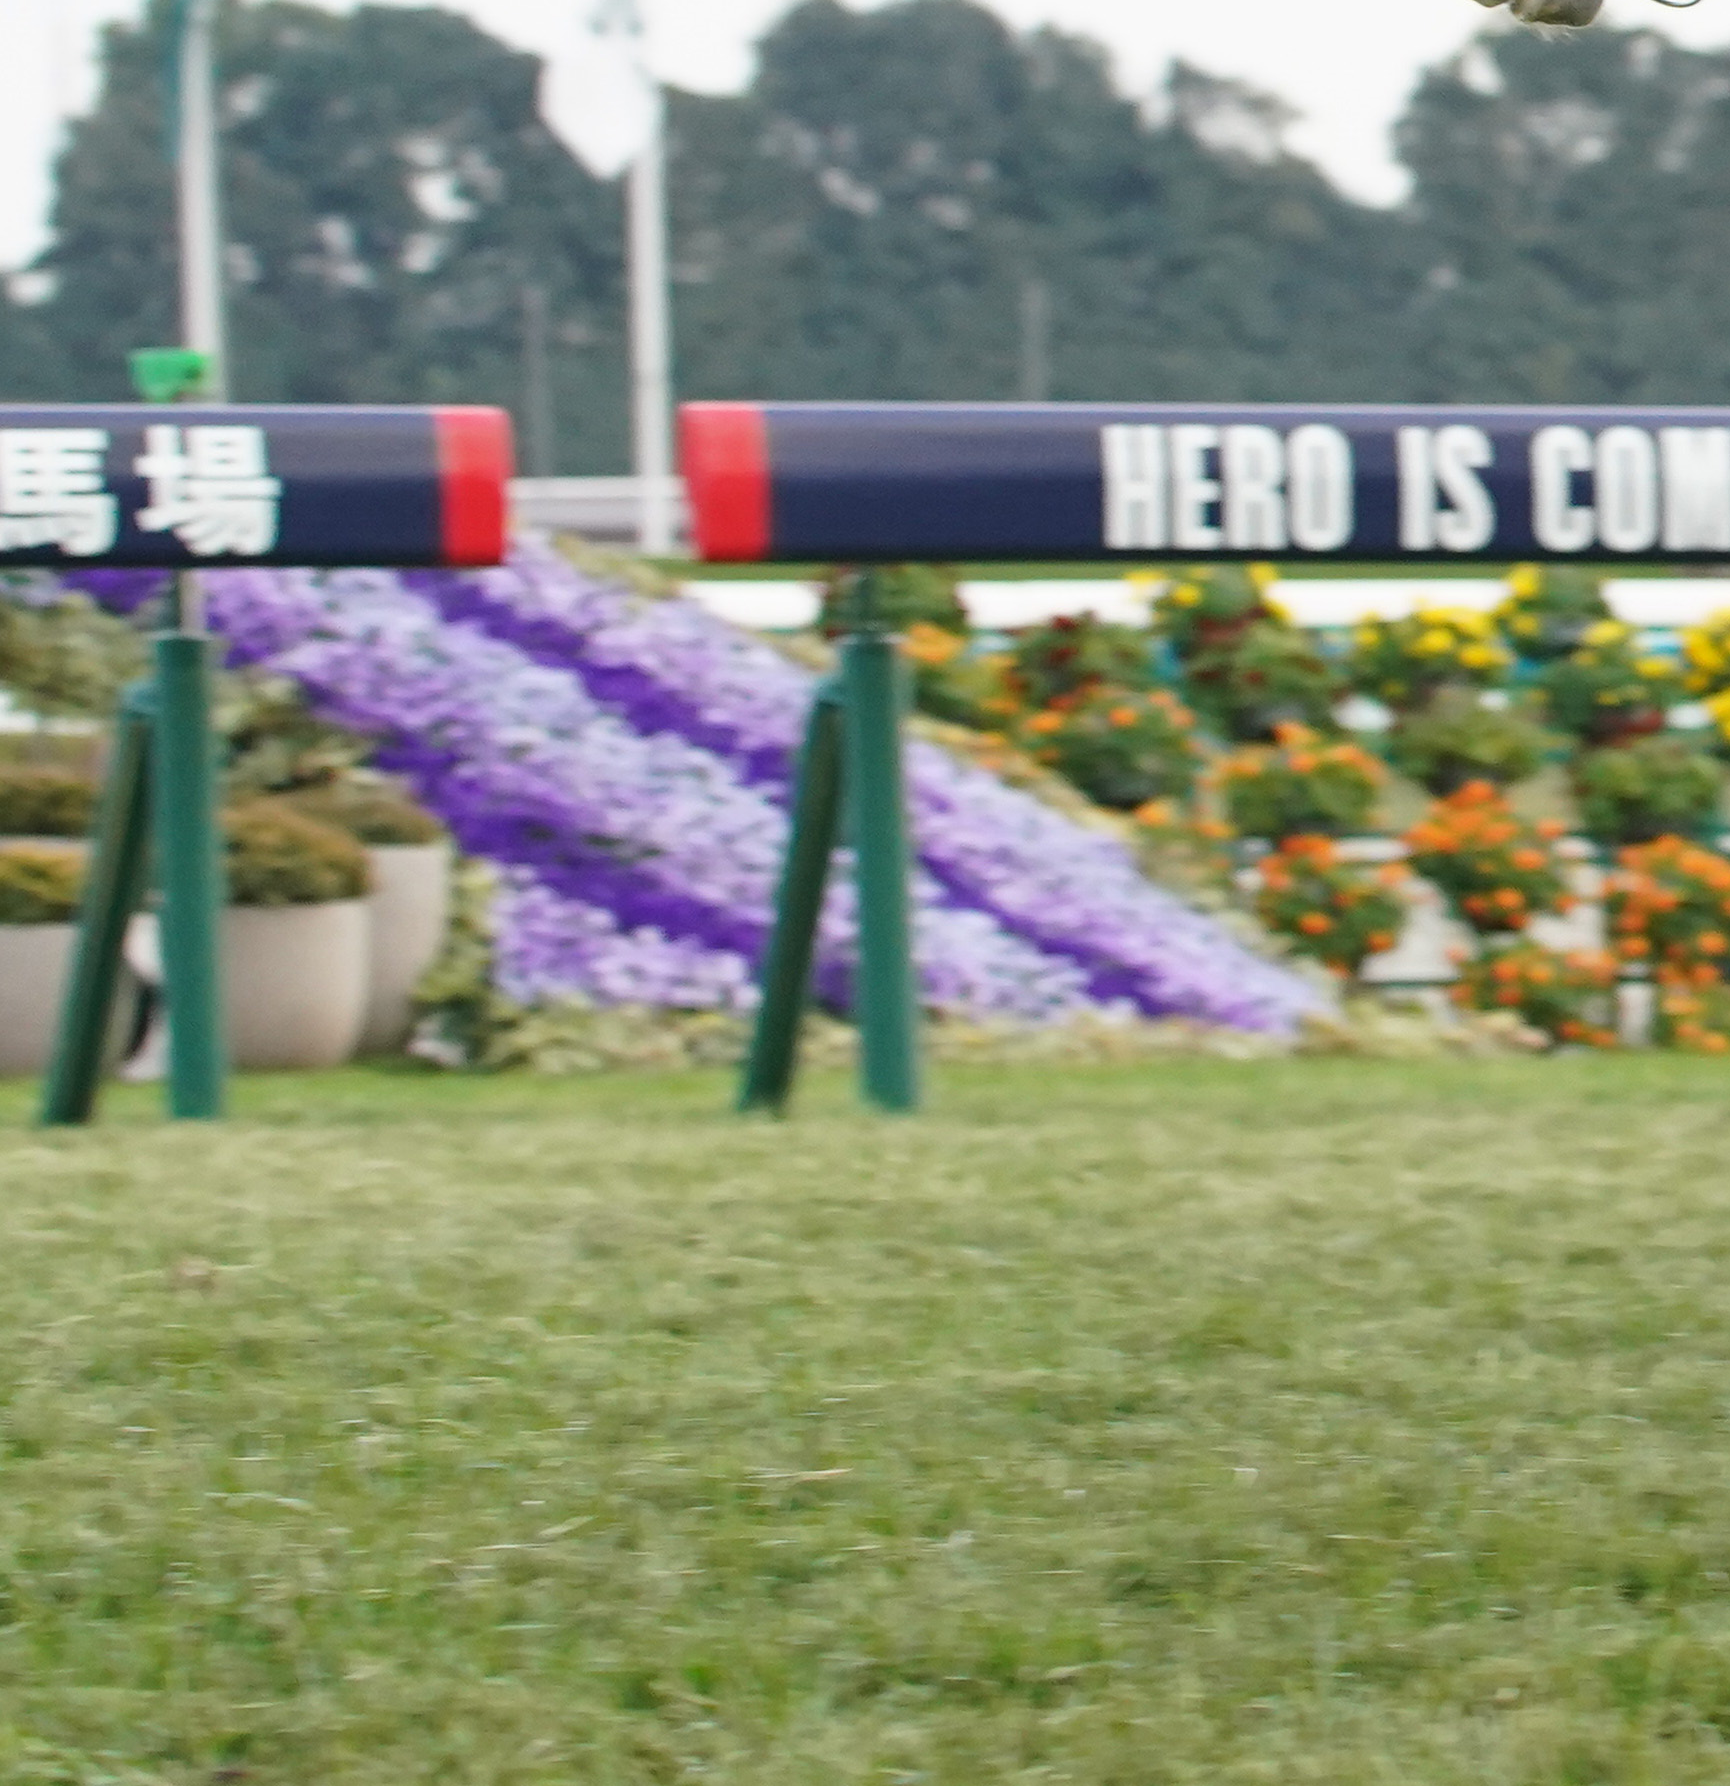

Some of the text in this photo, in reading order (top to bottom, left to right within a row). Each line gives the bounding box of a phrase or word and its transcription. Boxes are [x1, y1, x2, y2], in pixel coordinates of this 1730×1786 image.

[0, 423, 282, 556] 馬場
[1098, 423, 1354, 551] HERO
[1397, 424, 1494, 552] IS
